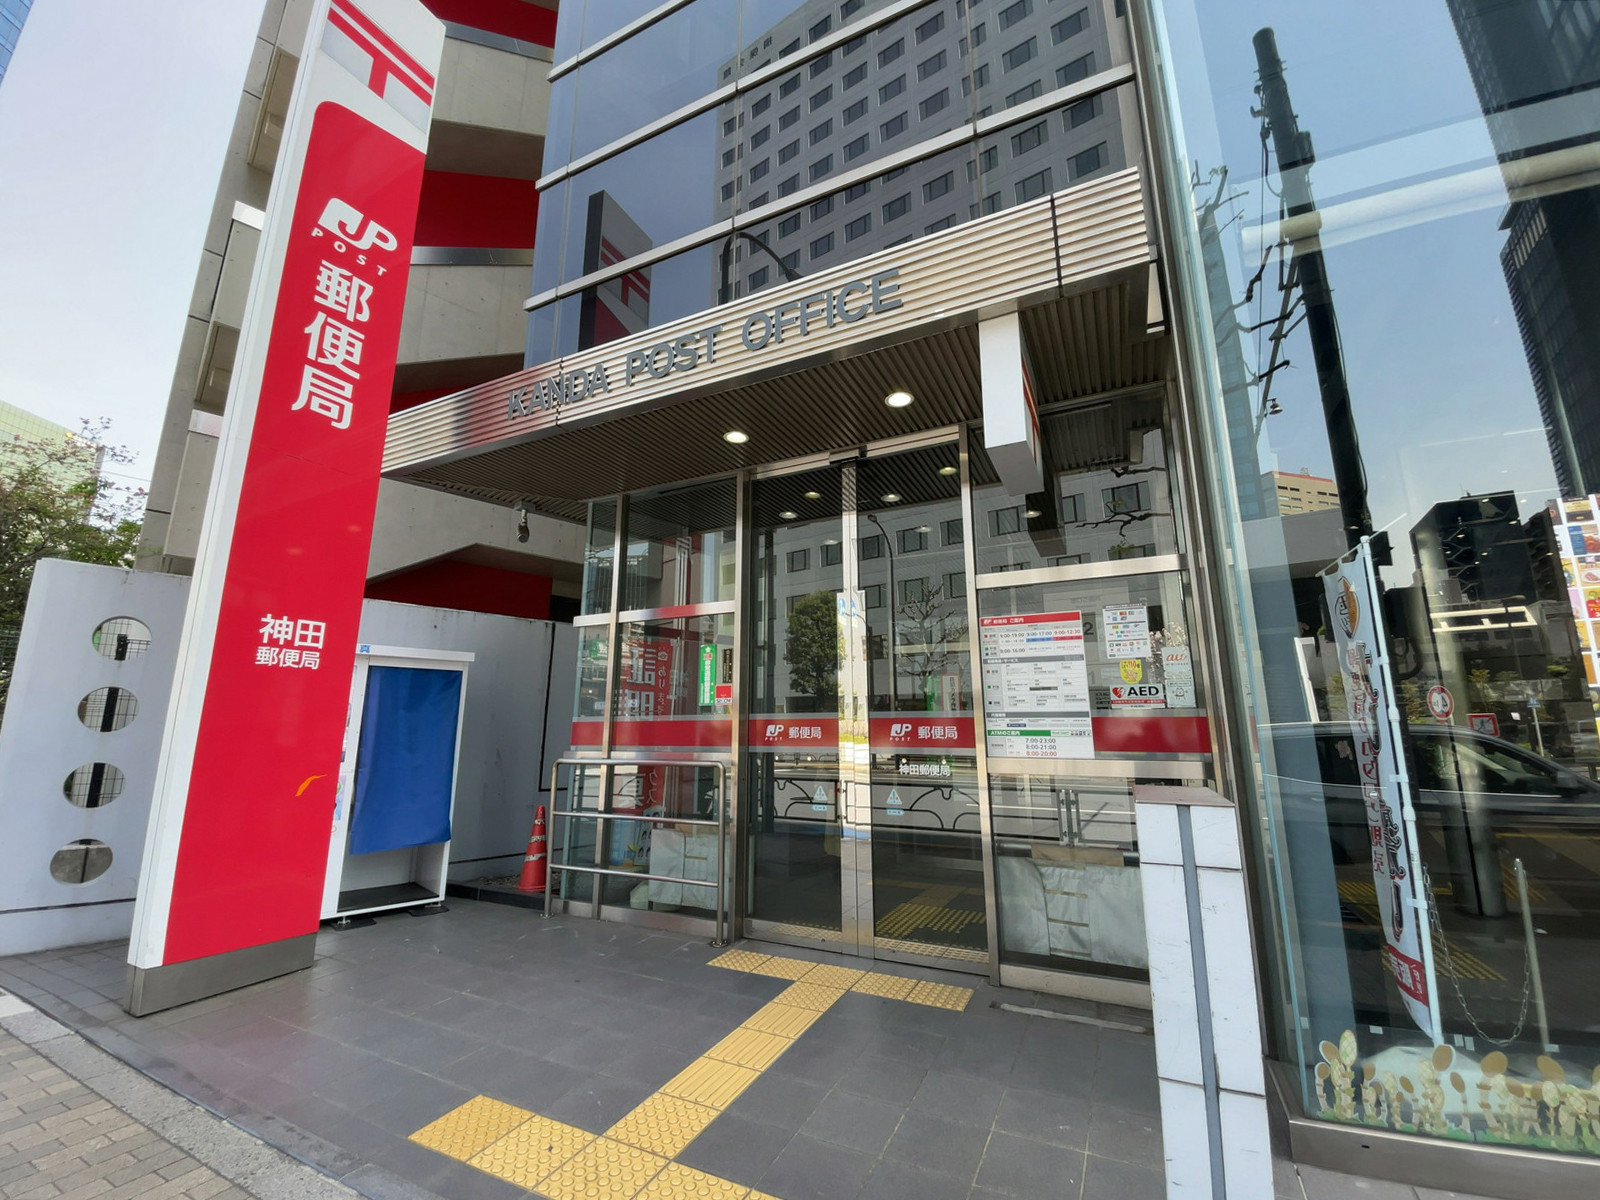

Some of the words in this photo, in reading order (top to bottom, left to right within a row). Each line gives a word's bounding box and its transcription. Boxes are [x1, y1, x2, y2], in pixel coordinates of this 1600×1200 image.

[311, 227, 387, 276] POST
[291, 259, 374, 430] 郵便局
[507, 363, 611, 420] KANDA
[625, 326, 723, 386] POST
[741, 269, 902, 352] OFFICE
[259, 613, 326, 649] 神田
[255, 646, 320, 670] 郵便局
[1127, 686, 1159, 697] AED
[788, 727, 822, 739] 郵便局
[917, 726, 957, 739] 郵便局
[898, 763, 951, 777] 神田郵便局
